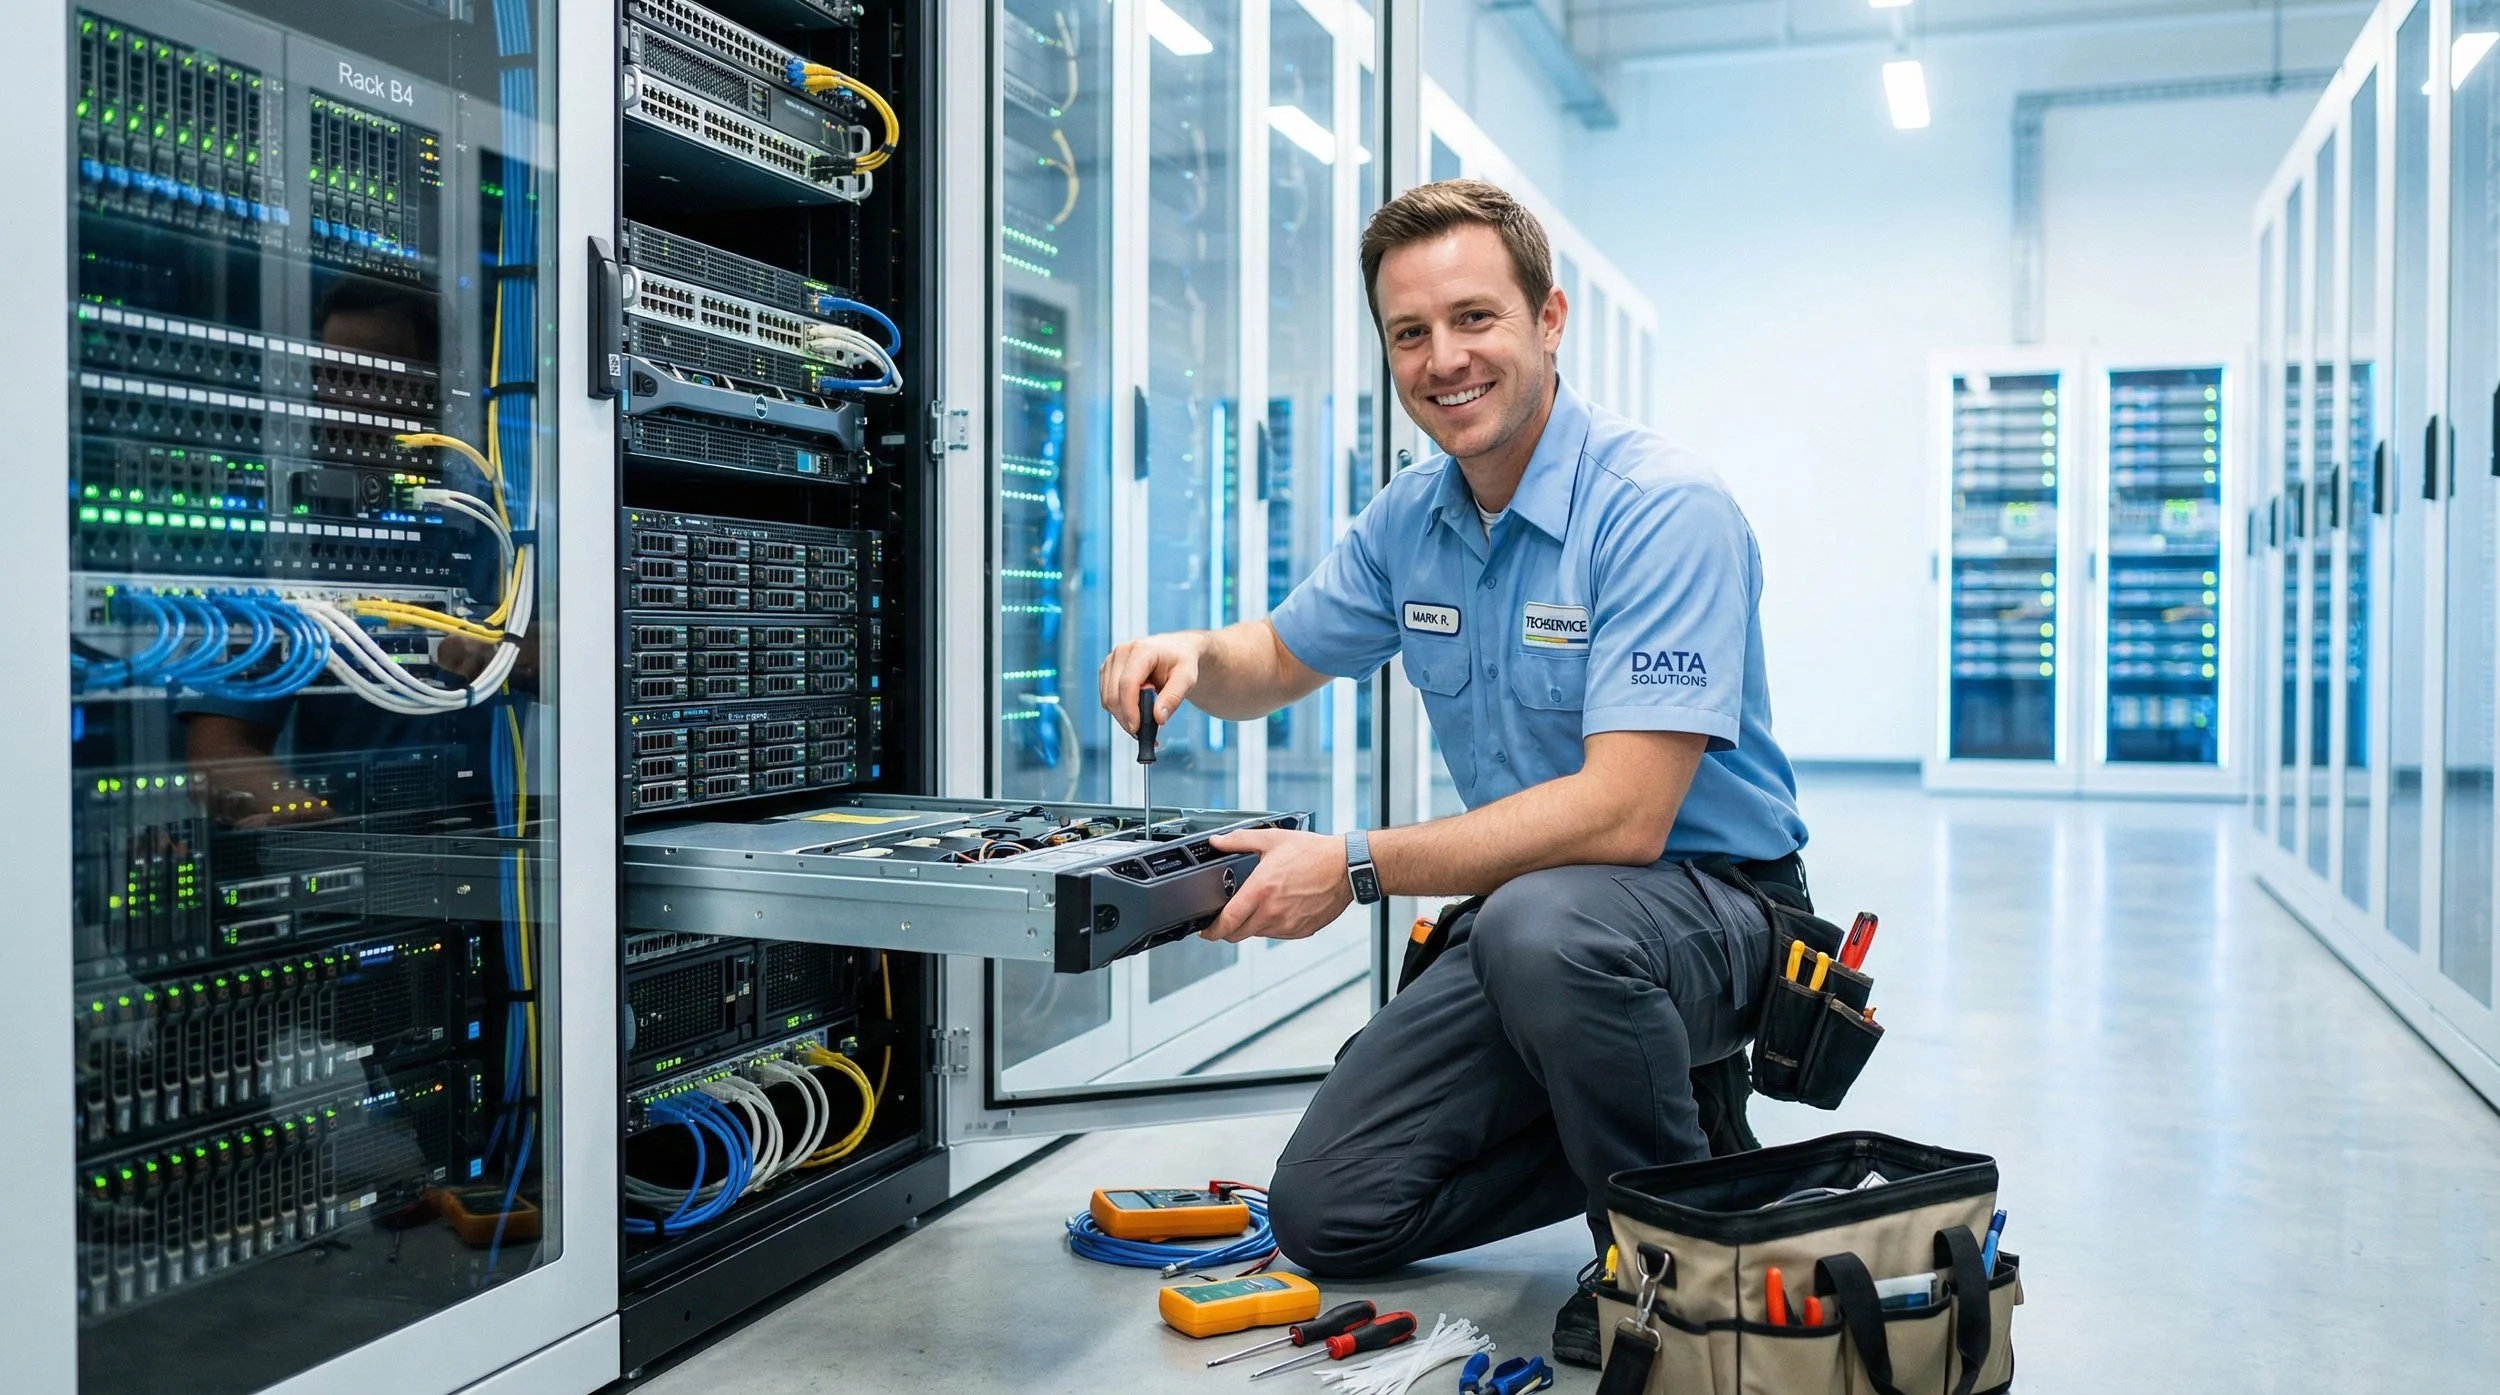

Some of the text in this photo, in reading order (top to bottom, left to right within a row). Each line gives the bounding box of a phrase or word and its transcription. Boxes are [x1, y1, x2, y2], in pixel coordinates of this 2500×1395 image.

[339, 62, 414, 107] Rack B4
[1412, 611, 1449, 626] MARK R.
[1632, 651, 1707, 674] DATA
[1631, 674, 1707, 687] SOLUTIONS
